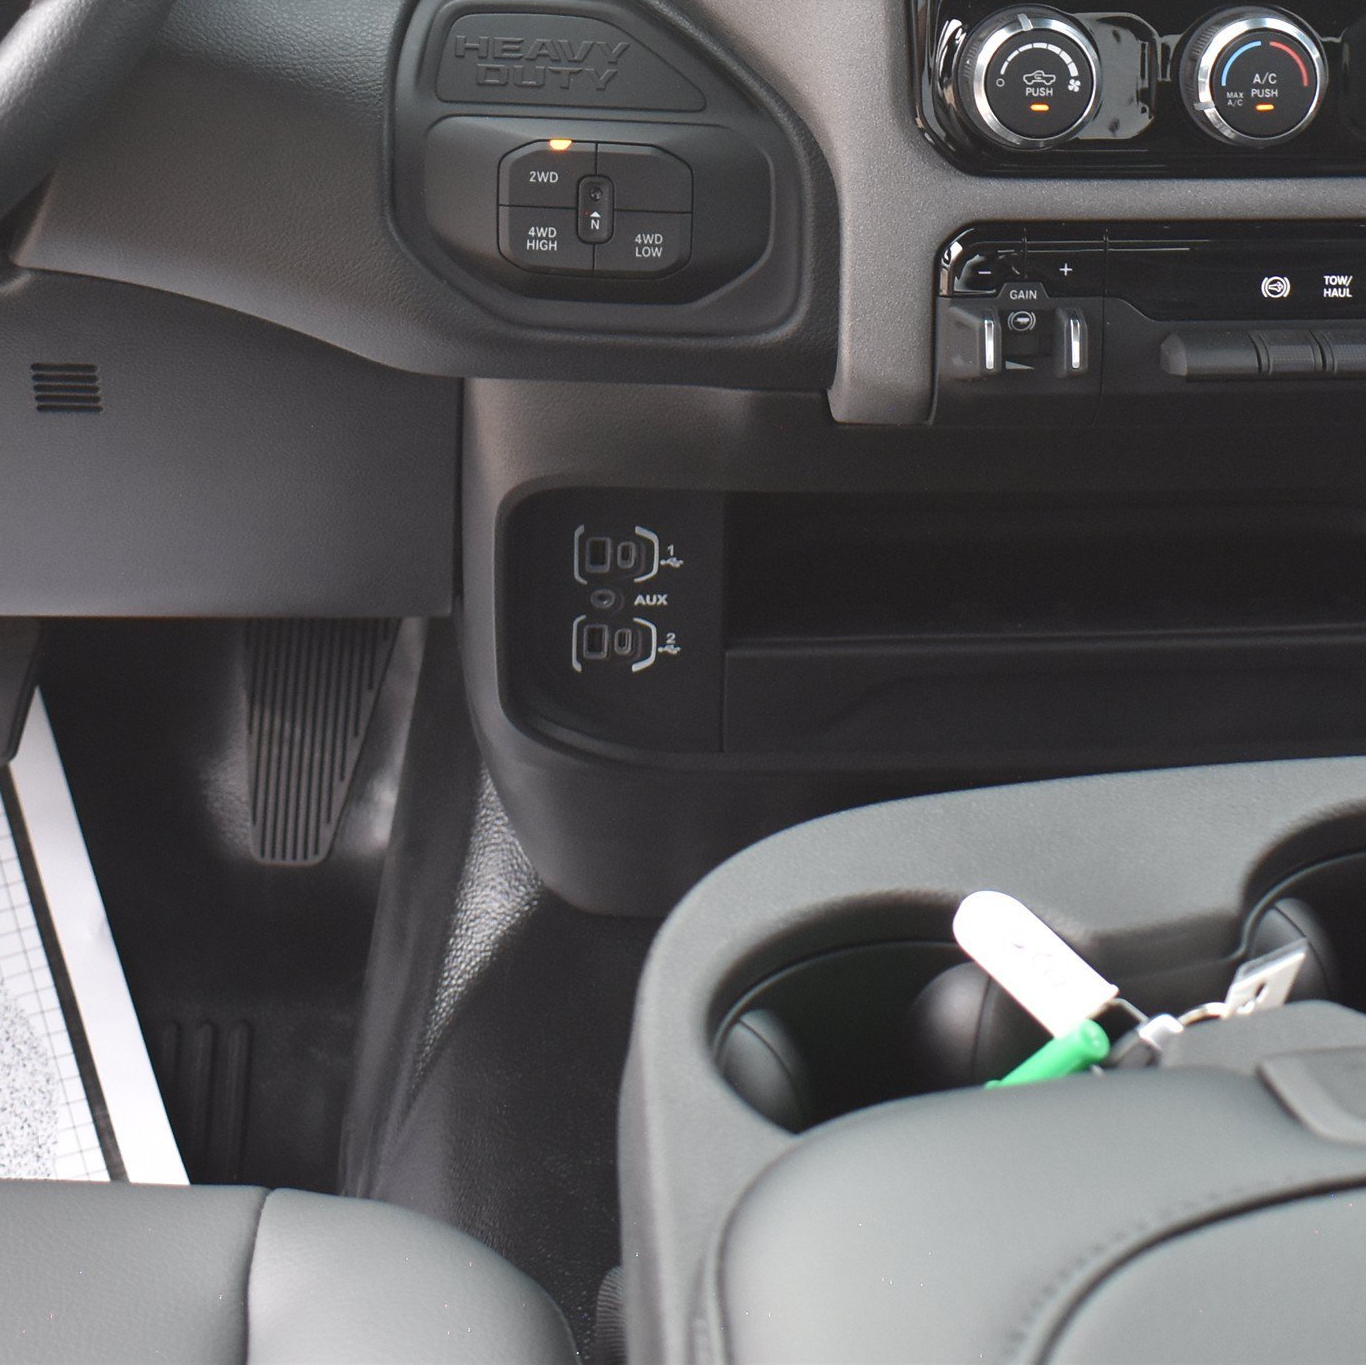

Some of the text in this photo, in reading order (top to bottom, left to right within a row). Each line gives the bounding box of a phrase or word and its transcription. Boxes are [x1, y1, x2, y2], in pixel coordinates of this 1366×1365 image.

[453, 35, 631, 65] HEAVY
[475, 62, 619, 91] DUTY
[1252, 72, 1278, 86] A/C
[1025, 87, 1054, 98] PUSH
[1226, 91, 1244, 100] MAX
[1250, 88, 1279, 99] PUSH
[1227, 99, 1244, 107] A/C
[528, 171, 559, 184] 2WD
[590, 219, 600, 231] N
[527, 226, 557, 240] 4WD
[526, 239, 558, 252] HIGH
[634, 233, 664, 246] 4WD
[635, 246, 664, 258] LOW
[1323, 275, 1354, 288] TOW/
[1009, 289, 1038, 301] GAIN
[1323, 287, 1353, 299] HAUL
[666, 544, 675, 556] 1
[634, 593, 669, 606] AUX
[665, 632, 676, 644] 2
